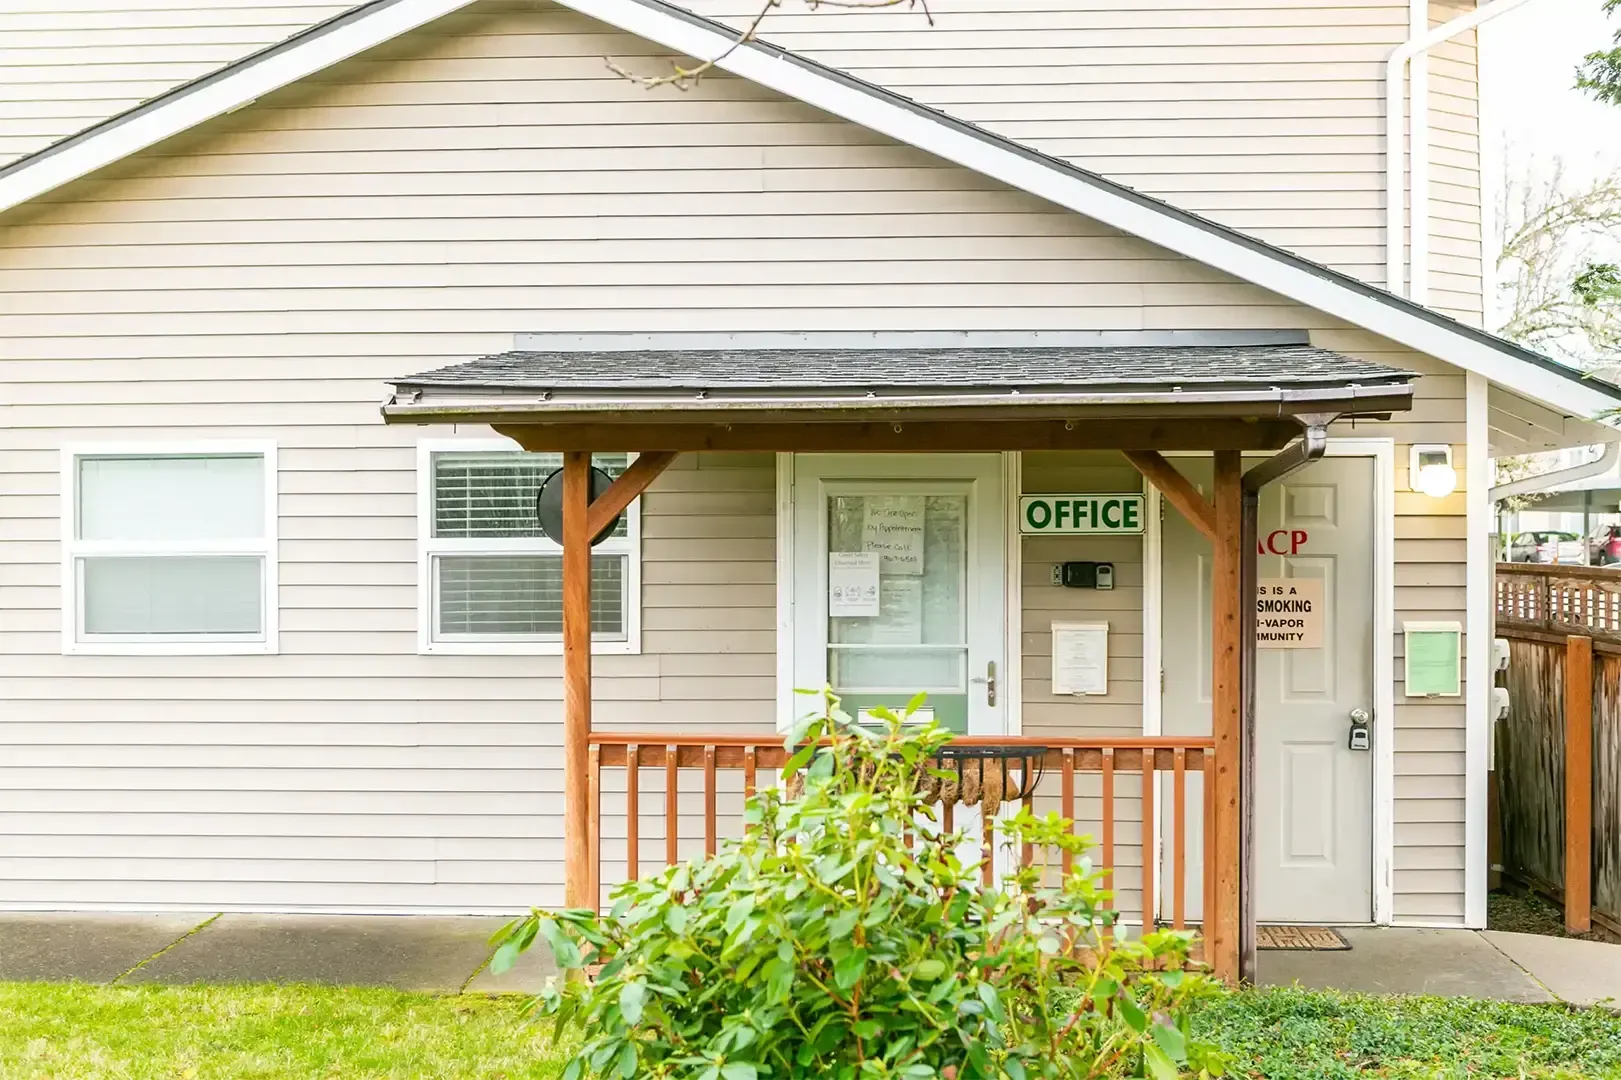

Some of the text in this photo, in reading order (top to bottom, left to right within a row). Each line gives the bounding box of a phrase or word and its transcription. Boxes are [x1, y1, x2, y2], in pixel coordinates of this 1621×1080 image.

[1026, 499, 1138, 529] OFFICE
[1257, 530, 1308, 555] CP
[1272, 586, 1284, 595] IS
[1289, 586, 1297, 595] A
[1257, 599, 1312, 613] SMOKING
[1257, 632, 1304, 641] MUNITY
